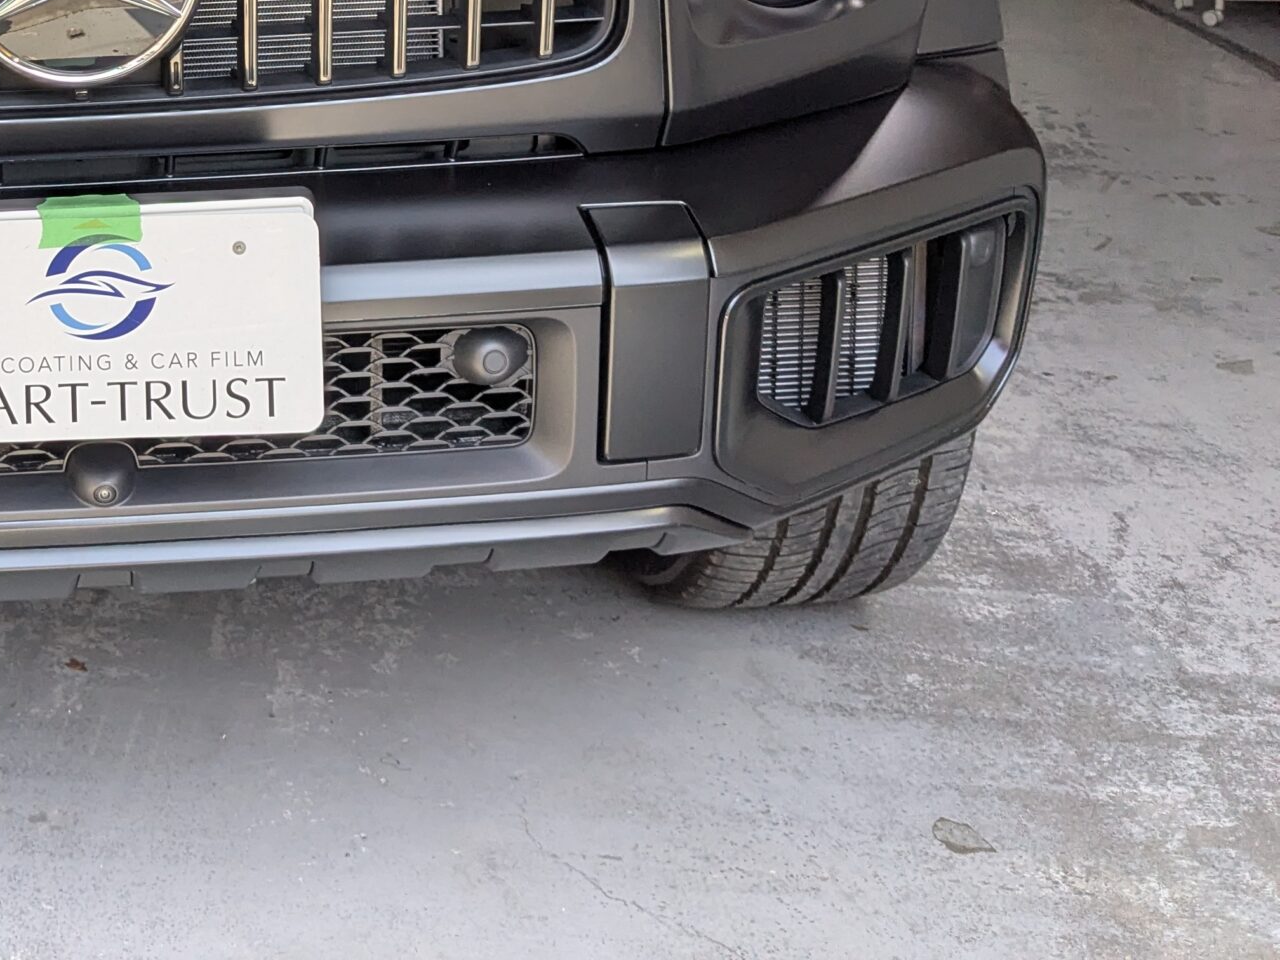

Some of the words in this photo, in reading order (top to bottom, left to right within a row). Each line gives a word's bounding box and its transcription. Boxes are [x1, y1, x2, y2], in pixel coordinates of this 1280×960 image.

[1, 353, 112, 373] COATING
[124, 353, 139, 370] &
[151, 351, 198, 369] CAR
[211, 350, 264, 367] FILM
